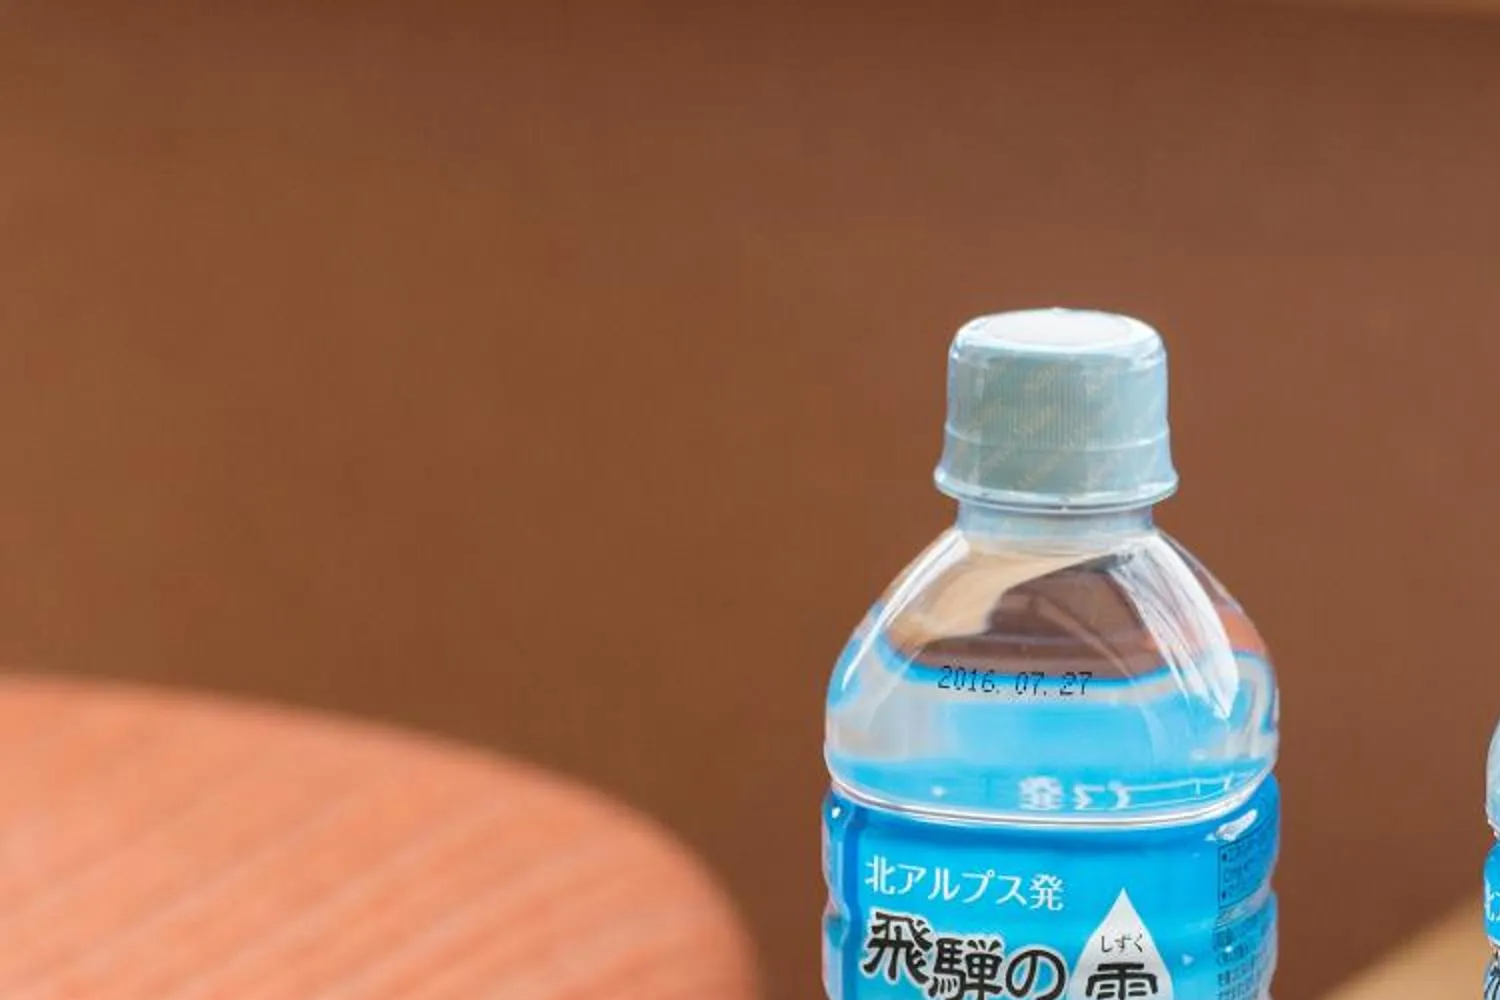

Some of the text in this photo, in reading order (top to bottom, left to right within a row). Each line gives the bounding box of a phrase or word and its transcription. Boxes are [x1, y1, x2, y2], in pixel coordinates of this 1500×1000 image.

[1059, 671, 1093, 696] 27
[865, 855, 1064, 911] 北アルプス発
[1100, 934, 1144, 953] しずく
